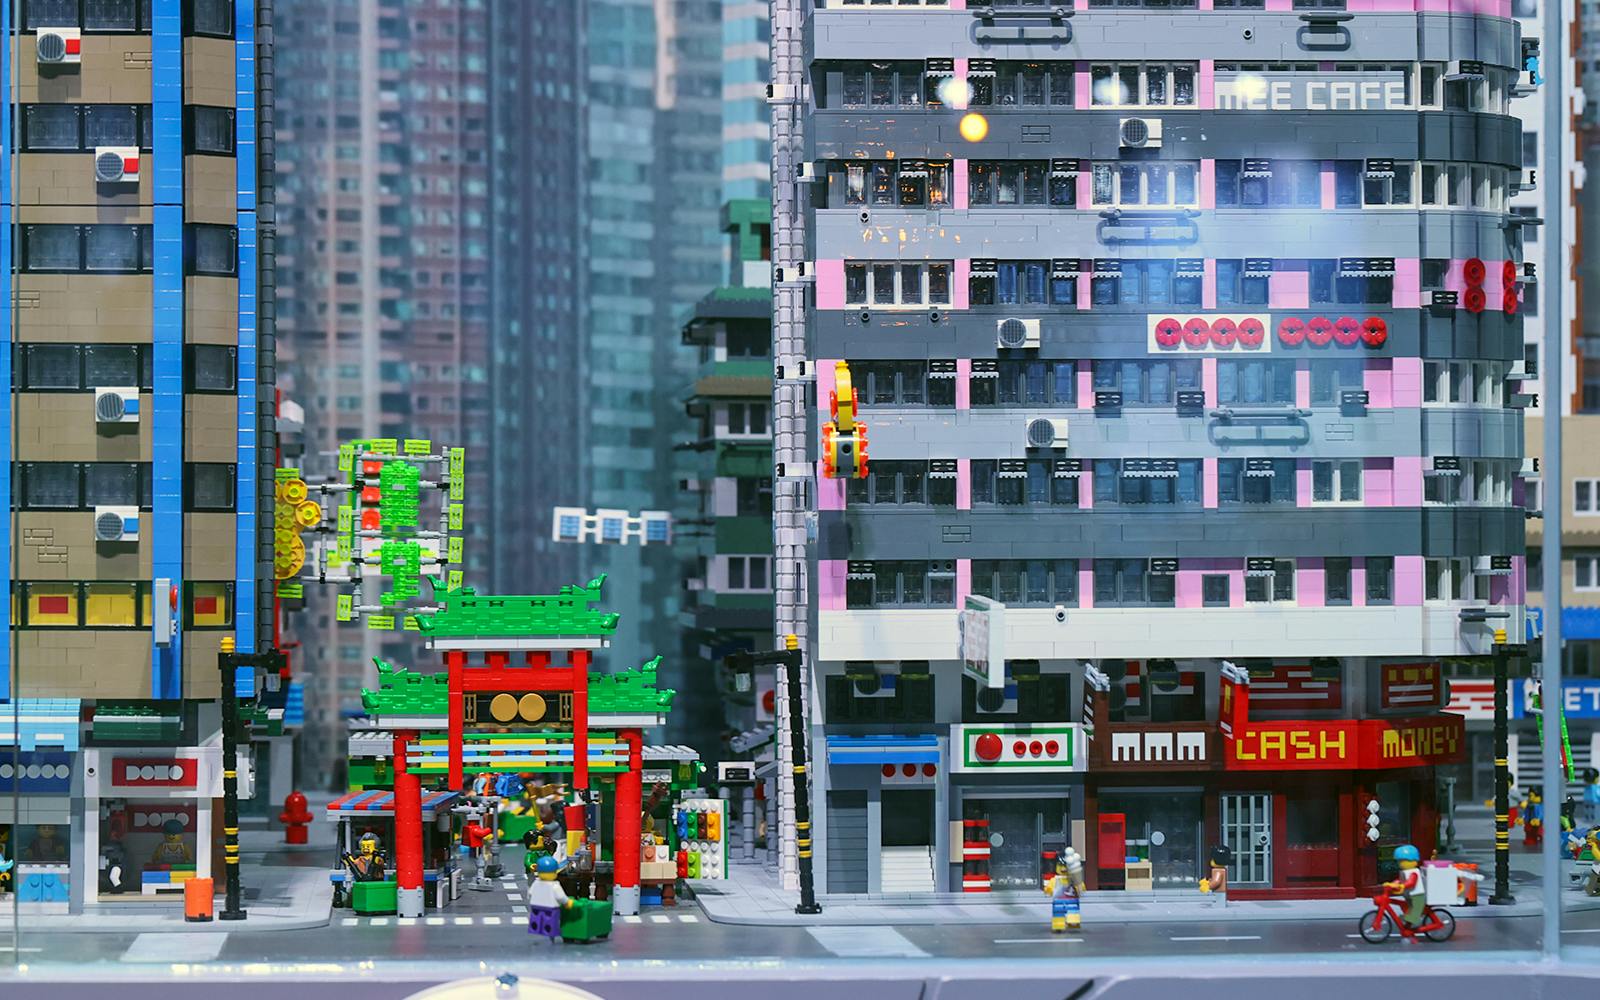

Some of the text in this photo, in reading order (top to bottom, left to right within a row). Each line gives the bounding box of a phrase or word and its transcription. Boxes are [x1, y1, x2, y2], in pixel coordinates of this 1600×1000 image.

[1306, 81, 1405, 110] CAFE
[1236, 726, 1459, 760] CASH MONEY
